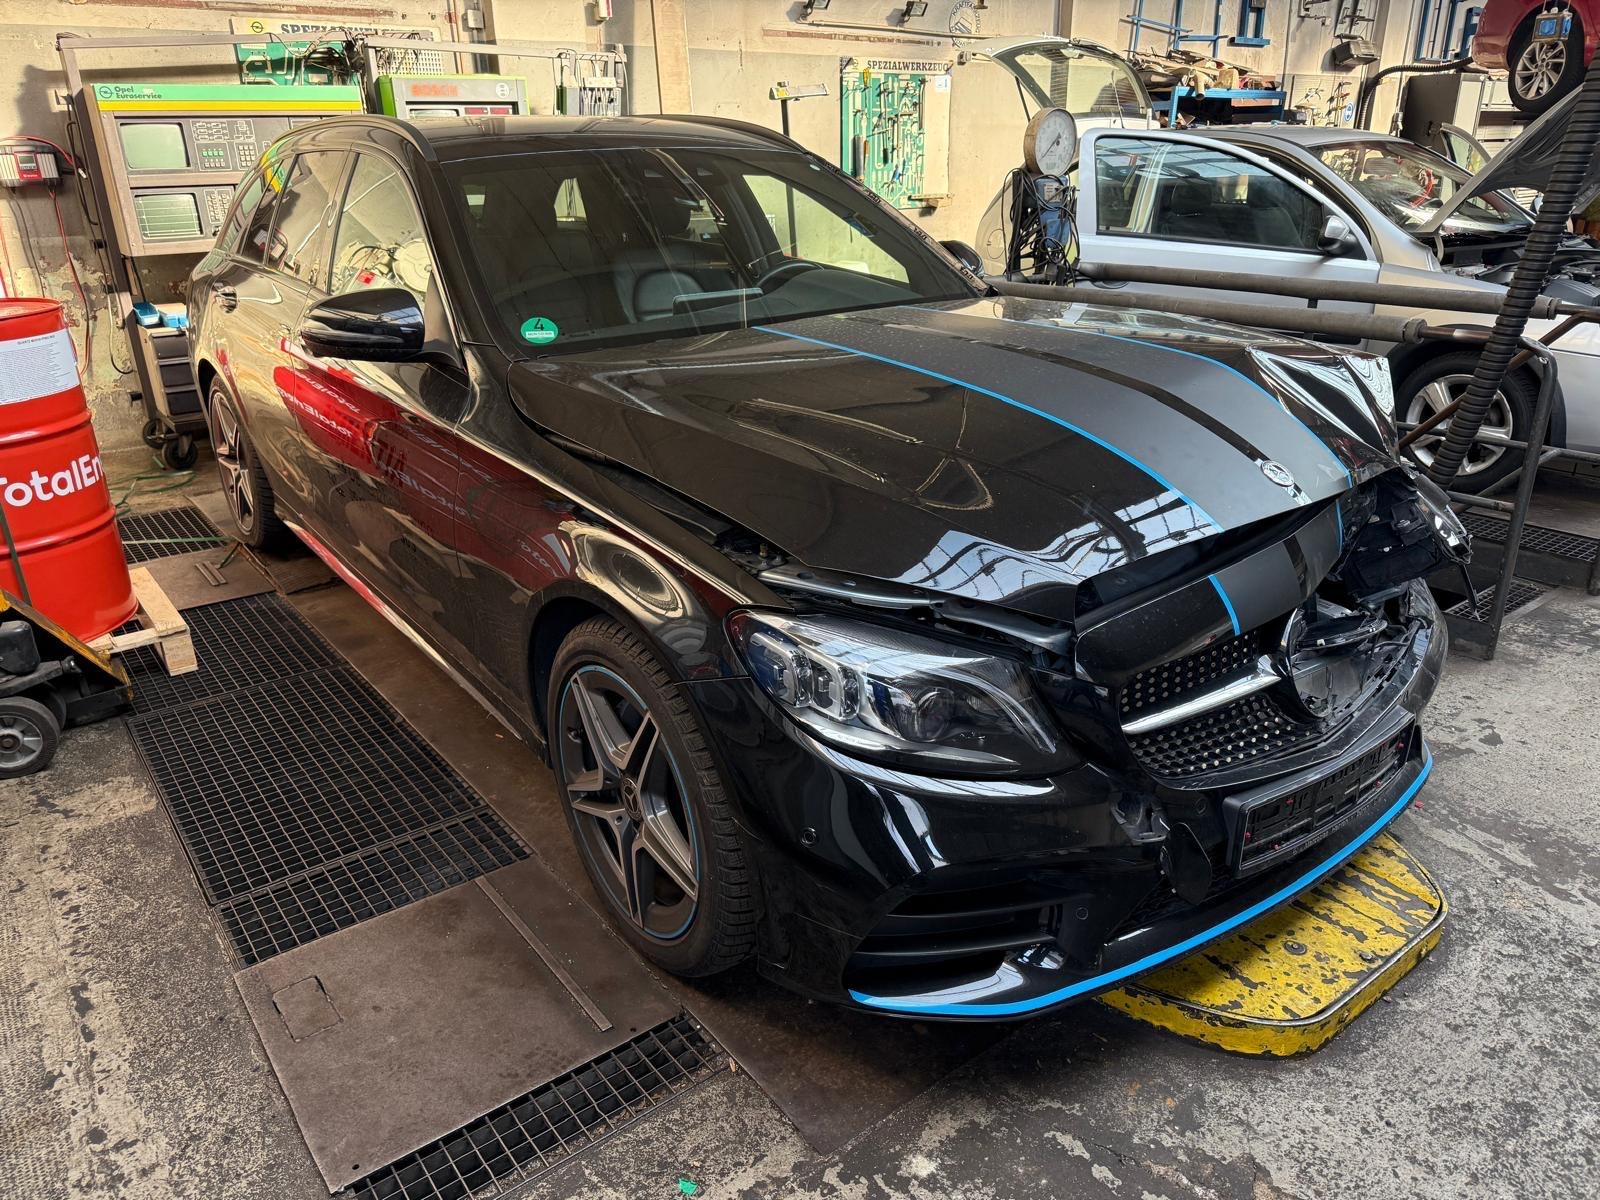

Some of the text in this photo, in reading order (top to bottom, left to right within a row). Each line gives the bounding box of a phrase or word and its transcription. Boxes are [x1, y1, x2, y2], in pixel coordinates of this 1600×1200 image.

[114, 82, 134, 93] Opel
[534, 319, 545, 331] 4
[0, 454, 104, 507] otalEn
